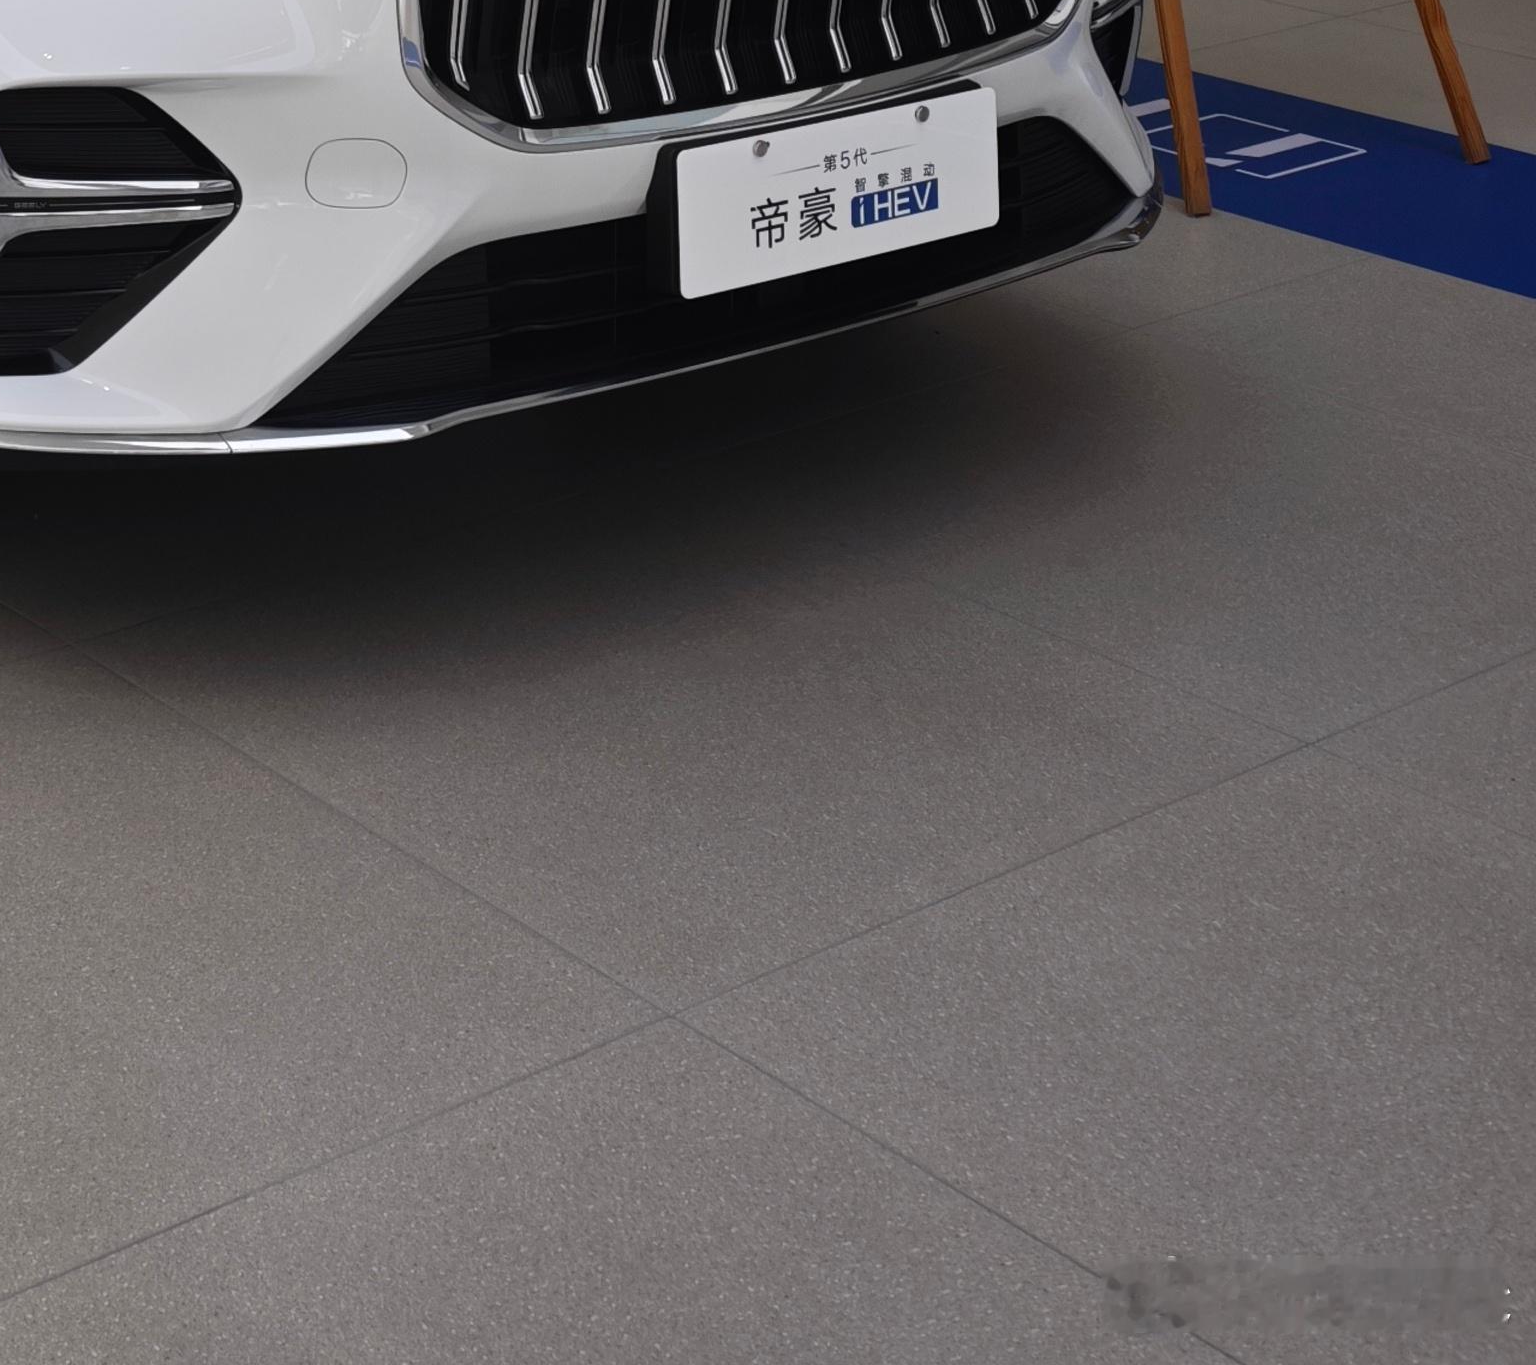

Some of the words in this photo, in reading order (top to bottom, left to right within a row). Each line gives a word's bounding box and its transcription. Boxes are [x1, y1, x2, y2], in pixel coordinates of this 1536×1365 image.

[822, 146, 869, 174] 第5代
[853, 161, 936, 194] 智擎混动
[750, 186, 838, 249] 帝豪
